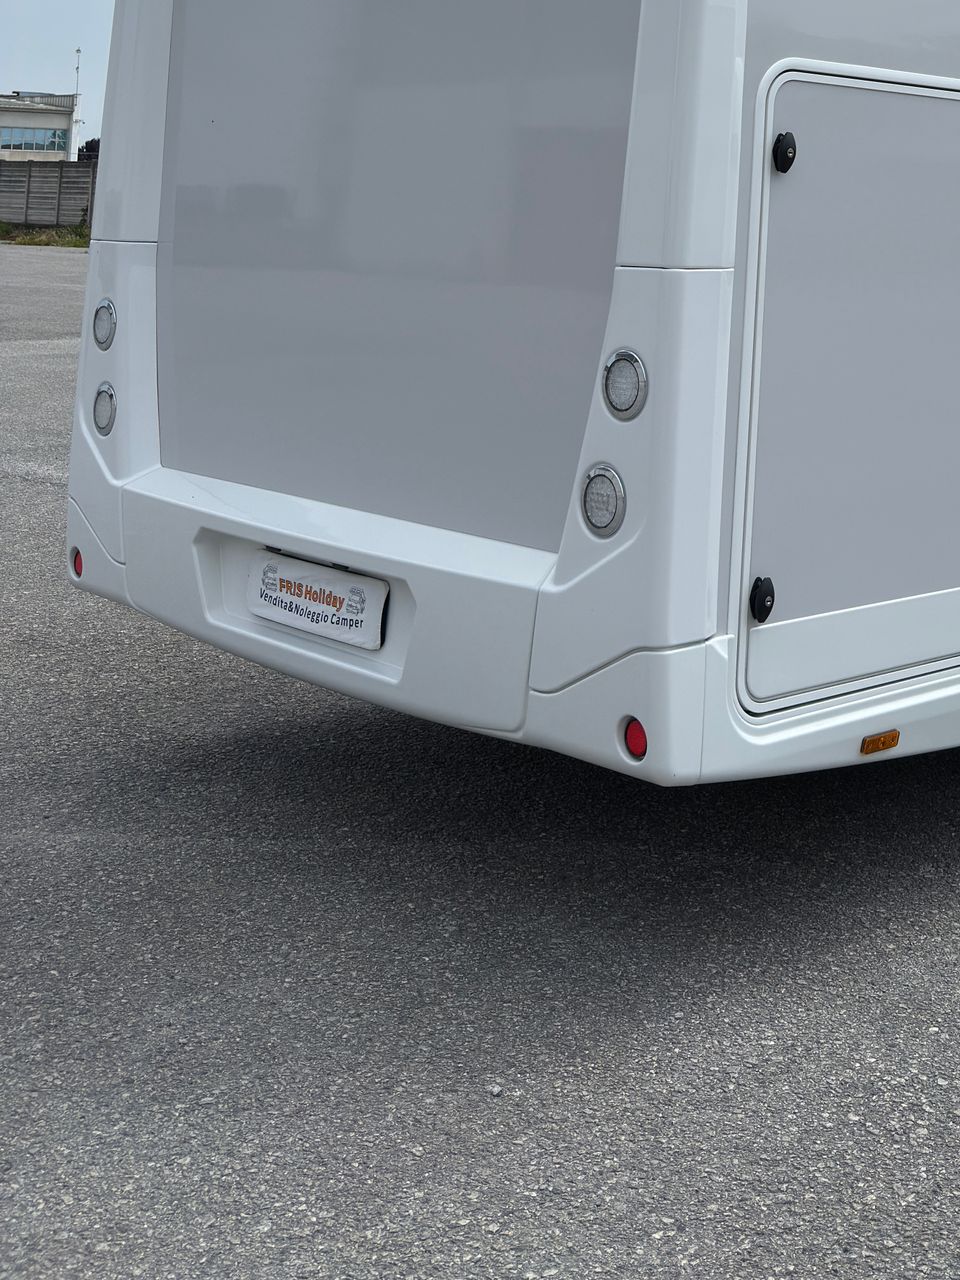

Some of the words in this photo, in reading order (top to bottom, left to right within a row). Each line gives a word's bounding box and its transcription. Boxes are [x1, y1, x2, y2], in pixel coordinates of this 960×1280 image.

[259, 587, 329, 624] Vendita&Noleggio
[330, 613, 364, 630] Camper
[278, 577, 304, 598] FRIS
[304, 585, 346, 612] Holiday
